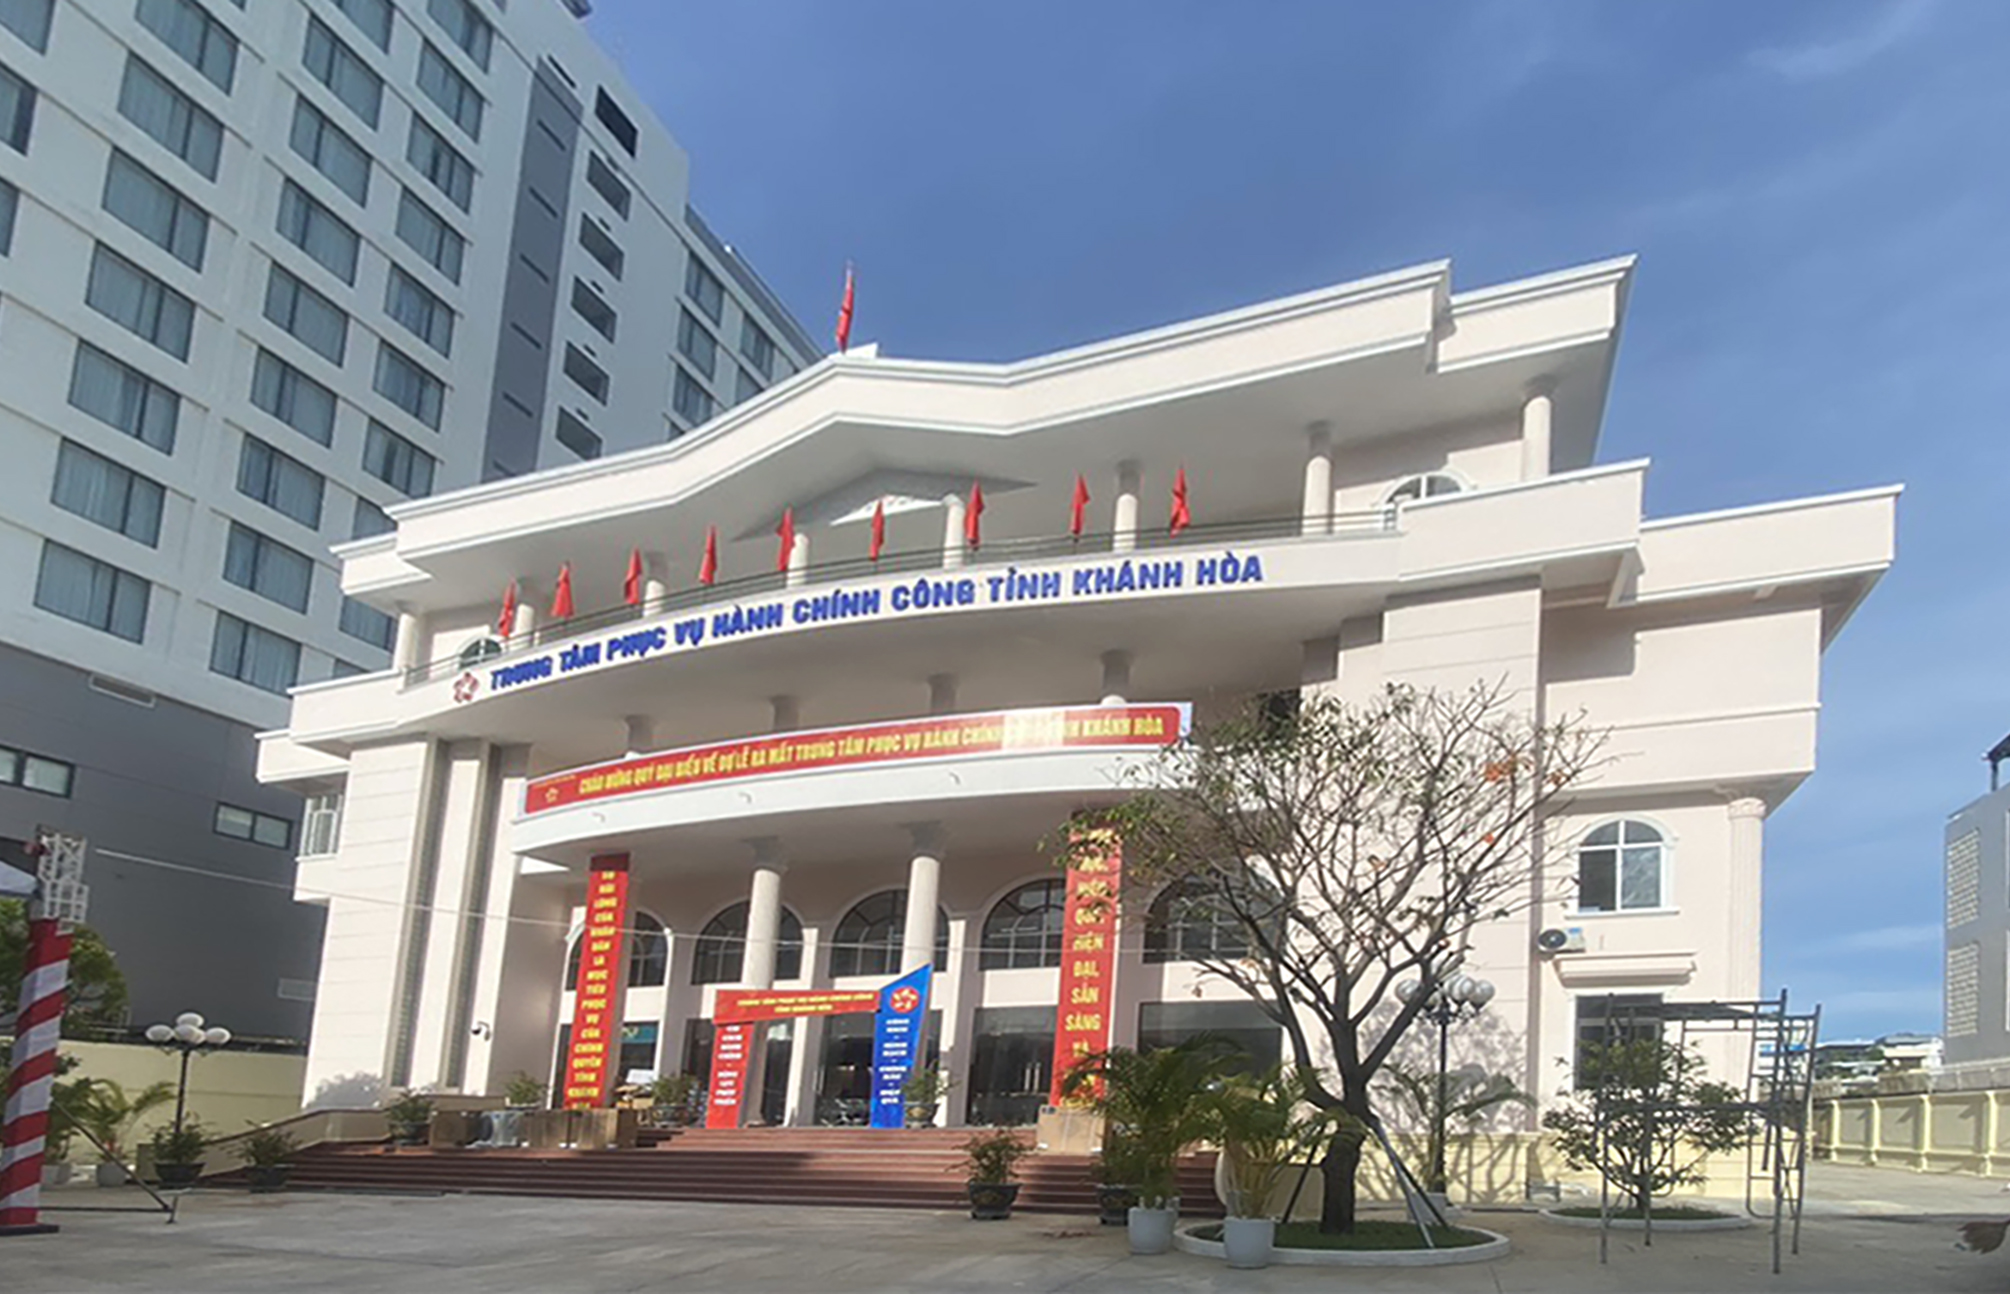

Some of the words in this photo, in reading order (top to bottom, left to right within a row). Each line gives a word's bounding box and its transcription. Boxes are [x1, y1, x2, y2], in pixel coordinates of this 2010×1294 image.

[490, 655, 553, 690] TRUNG
[559, 643, 602, 672] TÂM
[607, 627, 667, 661] PHỤC
[674, 618, 705, 646] VỤ
[712, 603, 784, 638] HÀNH
[793, 590, 880, 624] CHÍNH
[891, 579, 975, 611] CÔNG
[988, 566, 1061, 602] TỈNH
[1072, 560, 1184, 596] KHÁNH
[1196, 552, 1263, 586] HÒA
[751, 749, 766, 767] RA
[796, 740, 835, 761] TRUNG
[838, 735, 864, 757] TÂM
[866, 734, 900, 755] PHỤC
[903, 731, 922, 752] VỤ
[923, 726, 960, 748] HÀNH
[1083, 714, 1131, 737] KHÁNH
[1134, 715, 1165, 735] HÒA
[1070, 981, 1099, 1004] SẴN
[1064, 1011, 1101, 1031] SÀNG
